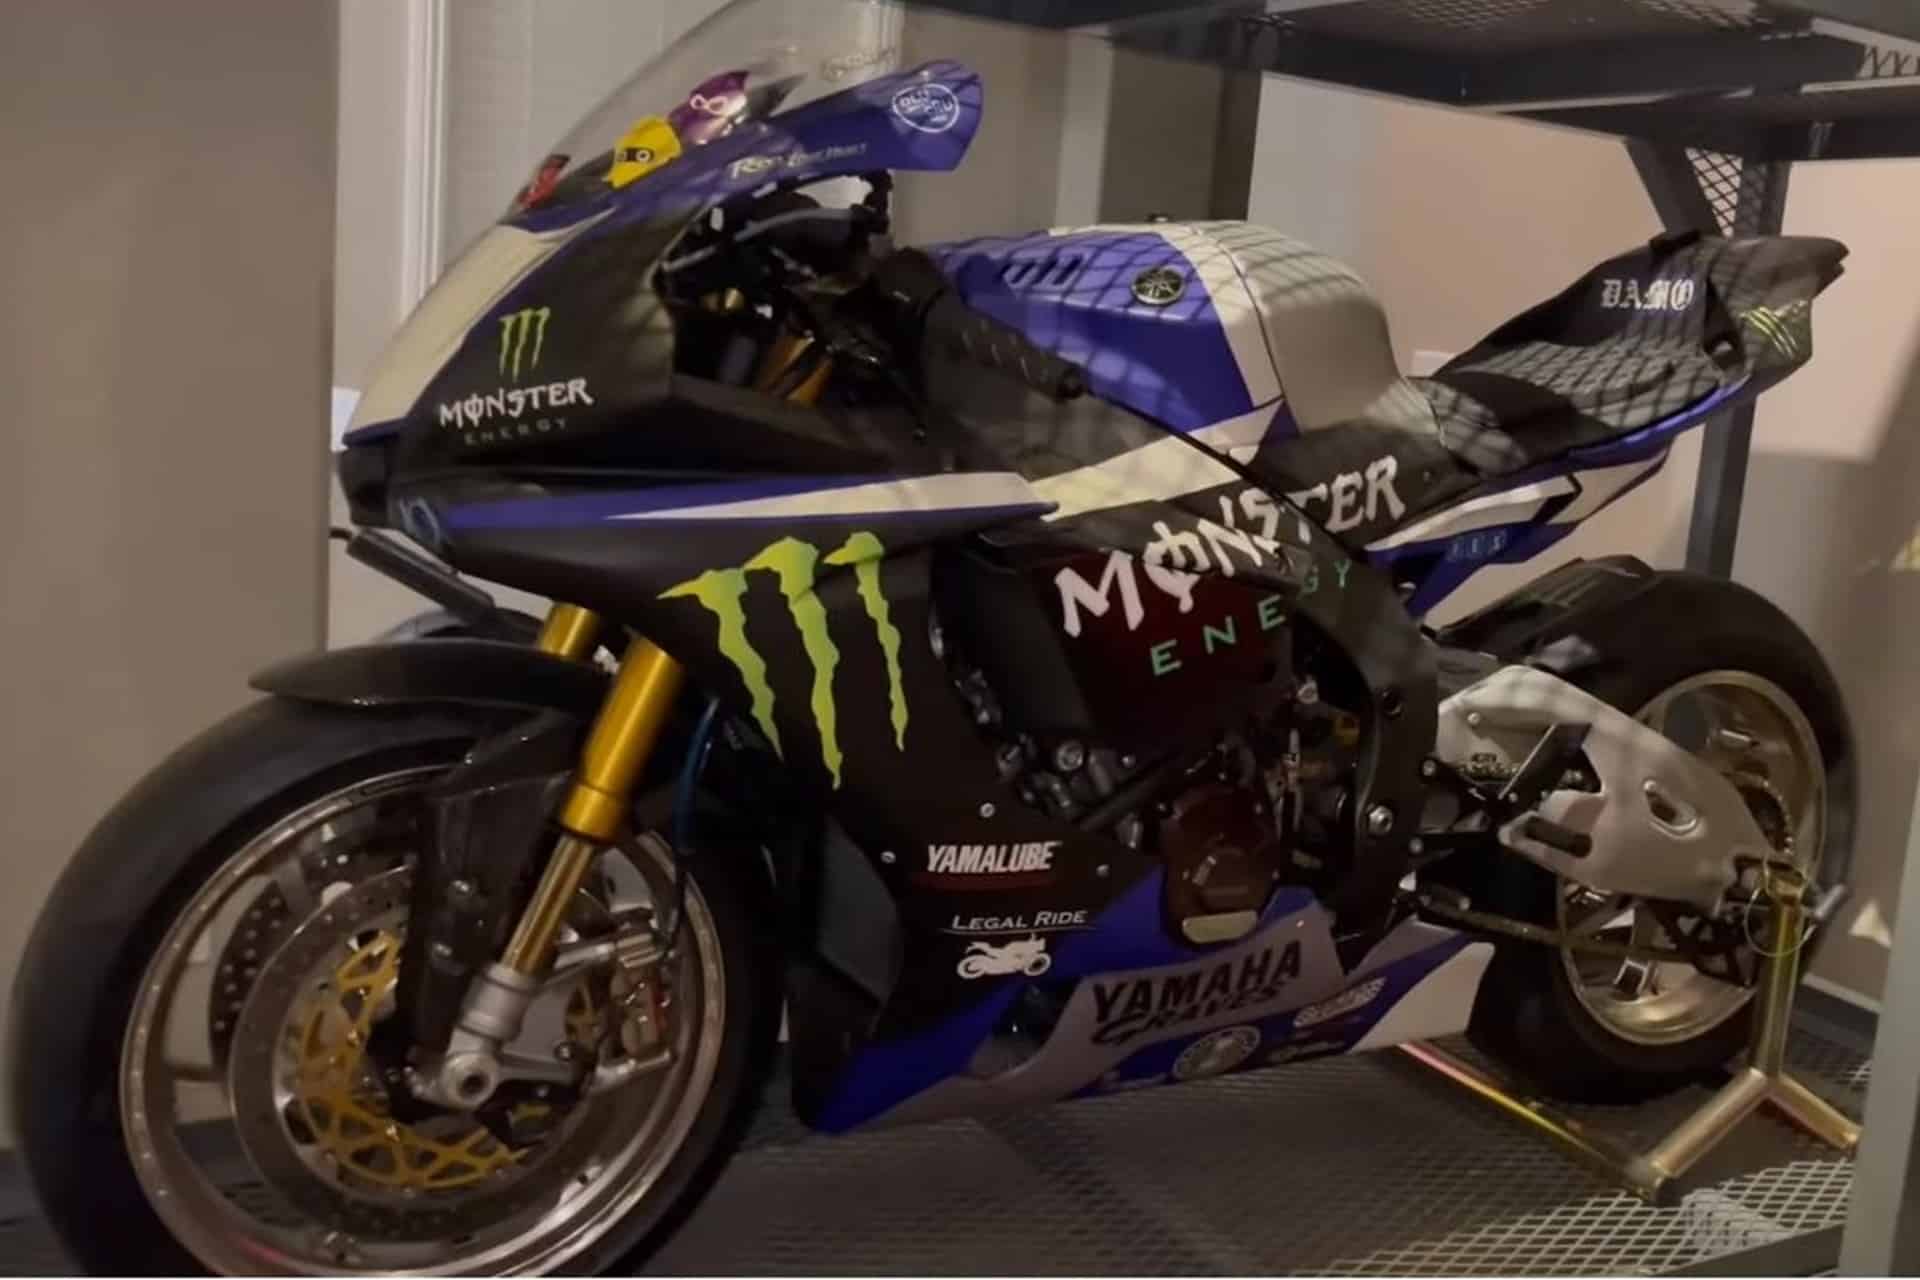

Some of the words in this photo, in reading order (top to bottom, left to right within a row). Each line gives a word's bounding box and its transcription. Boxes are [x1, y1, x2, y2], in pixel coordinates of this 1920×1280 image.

[1150, 558, 1351, 675] ENEGY
[926, 840, 1062, 874] YAMALUBE
[1092, 940, 1300, 1022] YAMAHA
